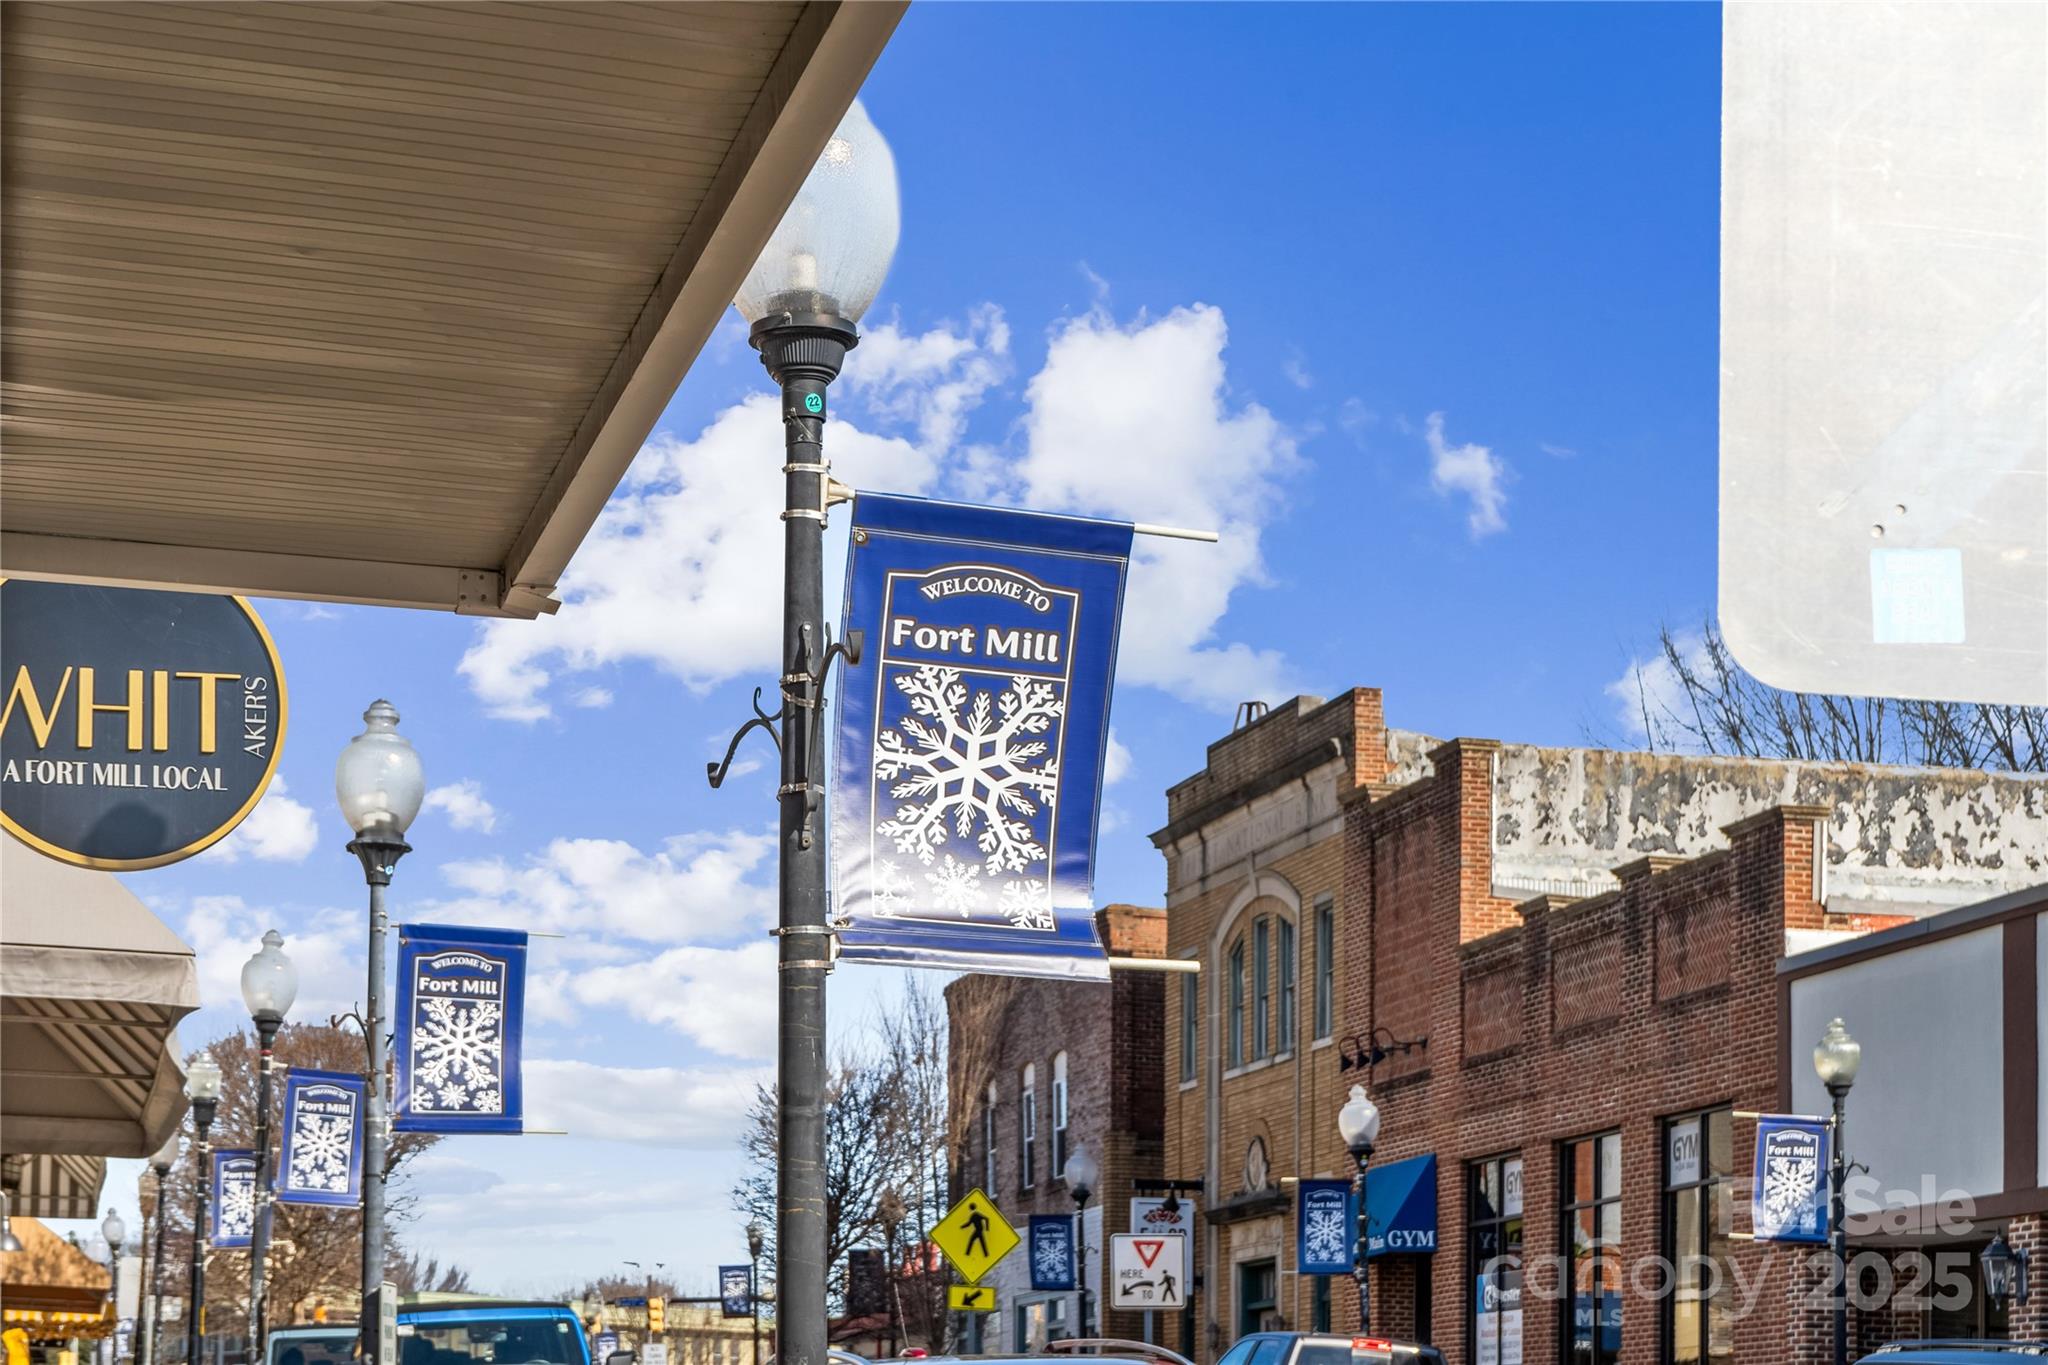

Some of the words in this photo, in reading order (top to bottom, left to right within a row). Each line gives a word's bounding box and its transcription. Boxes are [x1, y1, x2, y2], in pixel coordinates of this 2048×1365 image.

[808, 396, 820, 407] 22
[920, 576, 1023, 602] WELCOME
[1024, 586, 1051, 613] TO
[893, 619, 973, 654] Fort
[986, 629, 1059, 663] Mill
[243, 676, 268, 759] AKER'S
[3, 759, 20, 783] A
[25, 759, 88, 785] FORT
[93, 763, 148, 788] MILL
[153, 765, 228, 791] LOCAL
[432, 957, 478, 970] WELCOME
[479, 963, 493, 973] TO
[419, 977, 459, 992] Fort
[462, 979, 498, 995] Mill
[298, 1100, 325, 1113] Fort
[326, 1103, 351, 1114] Mill
[1673, 1133, 1698, 1163] GYM
[1768, 1145, 1792, 1155] Fort
[1793, 1145, 1814, 1157] Mill
[1307, 1201, 1325, 1209] Fort
[1387, 1230, 1435, 1247] GYM
[1120, 1269, 1144, 1279] HERE
[1142, 1290, 1153, 1300] TO
